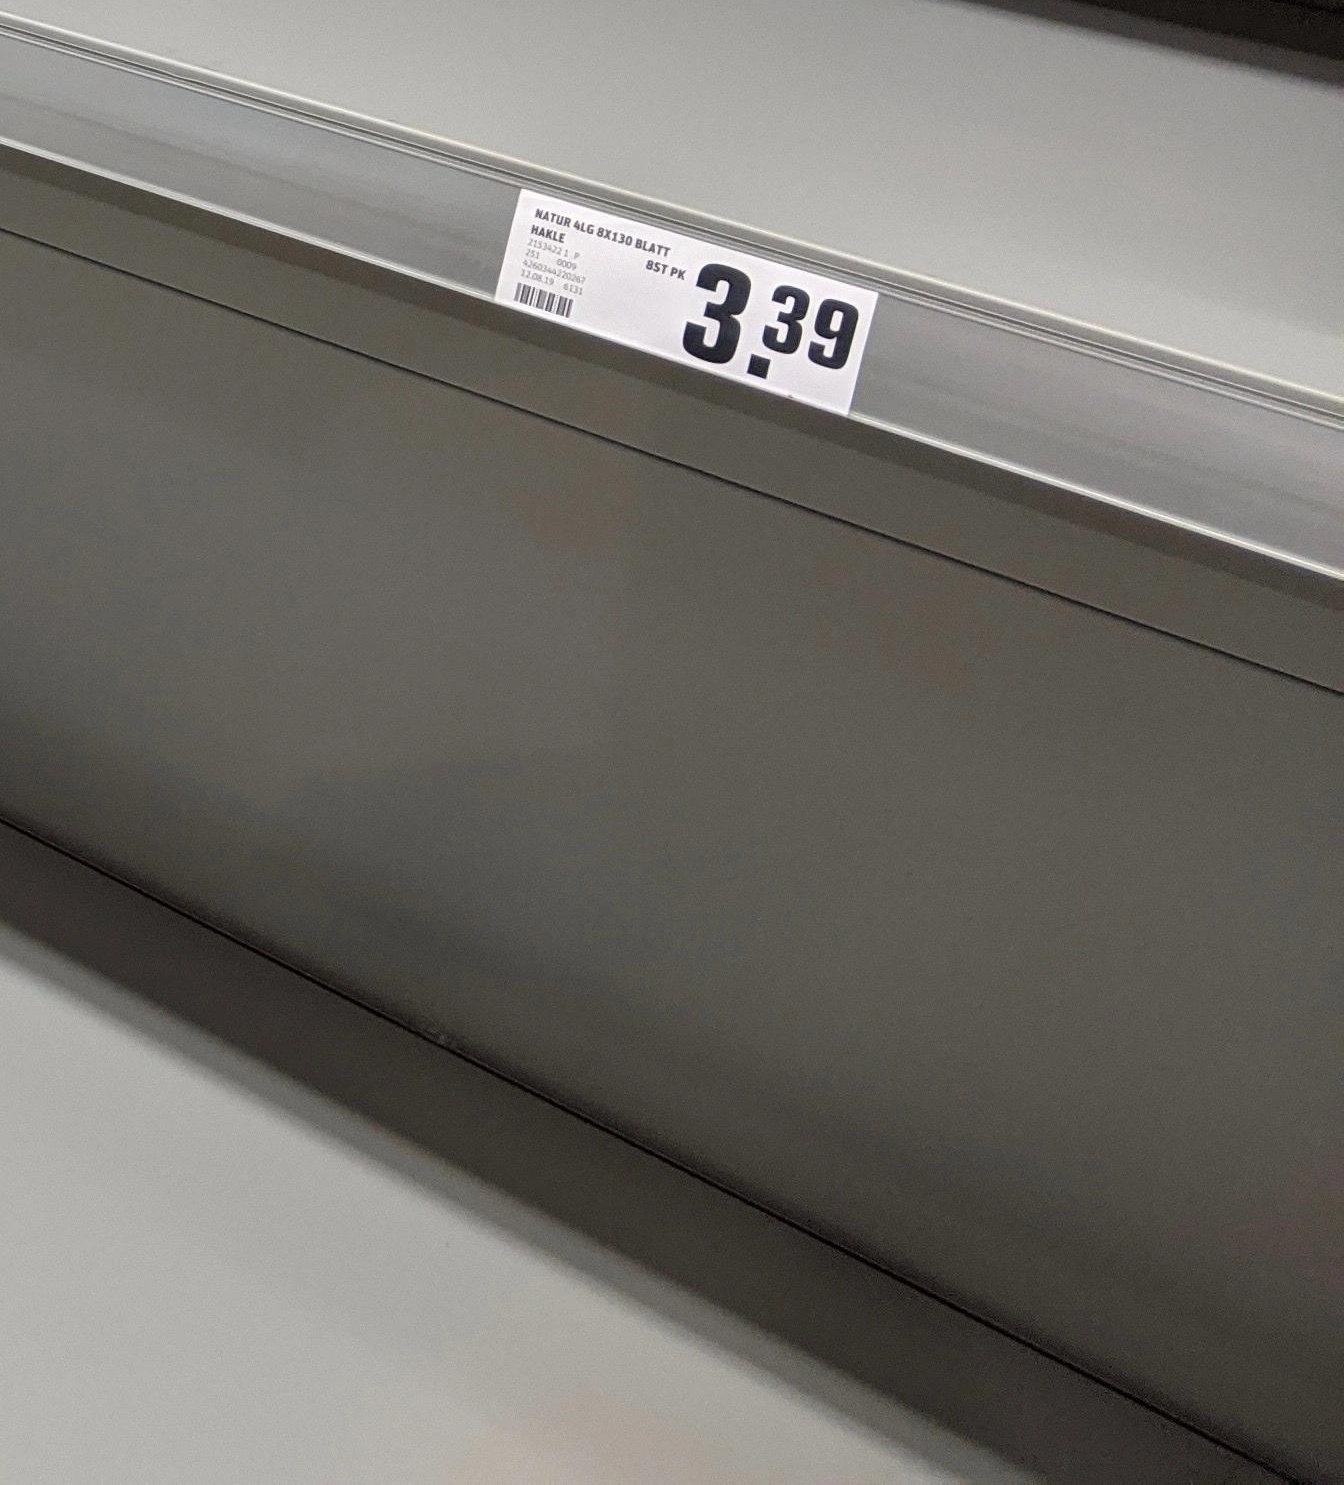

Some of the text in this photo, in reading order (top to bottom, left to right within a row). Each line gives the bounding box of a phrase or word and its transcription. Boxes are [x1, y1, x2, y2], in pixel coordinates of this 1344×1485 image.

[530, 224, 566, 244] HAKLE
[534, 208, 671, 258] NATUR 4LG 8X130 BLATT
[525, 249, 540, 259] 251
[527, 238, 561, 256] 2153422
[646, 259, 687, 281] 8ST PK
[682, 263, 859, 379] 3.39
